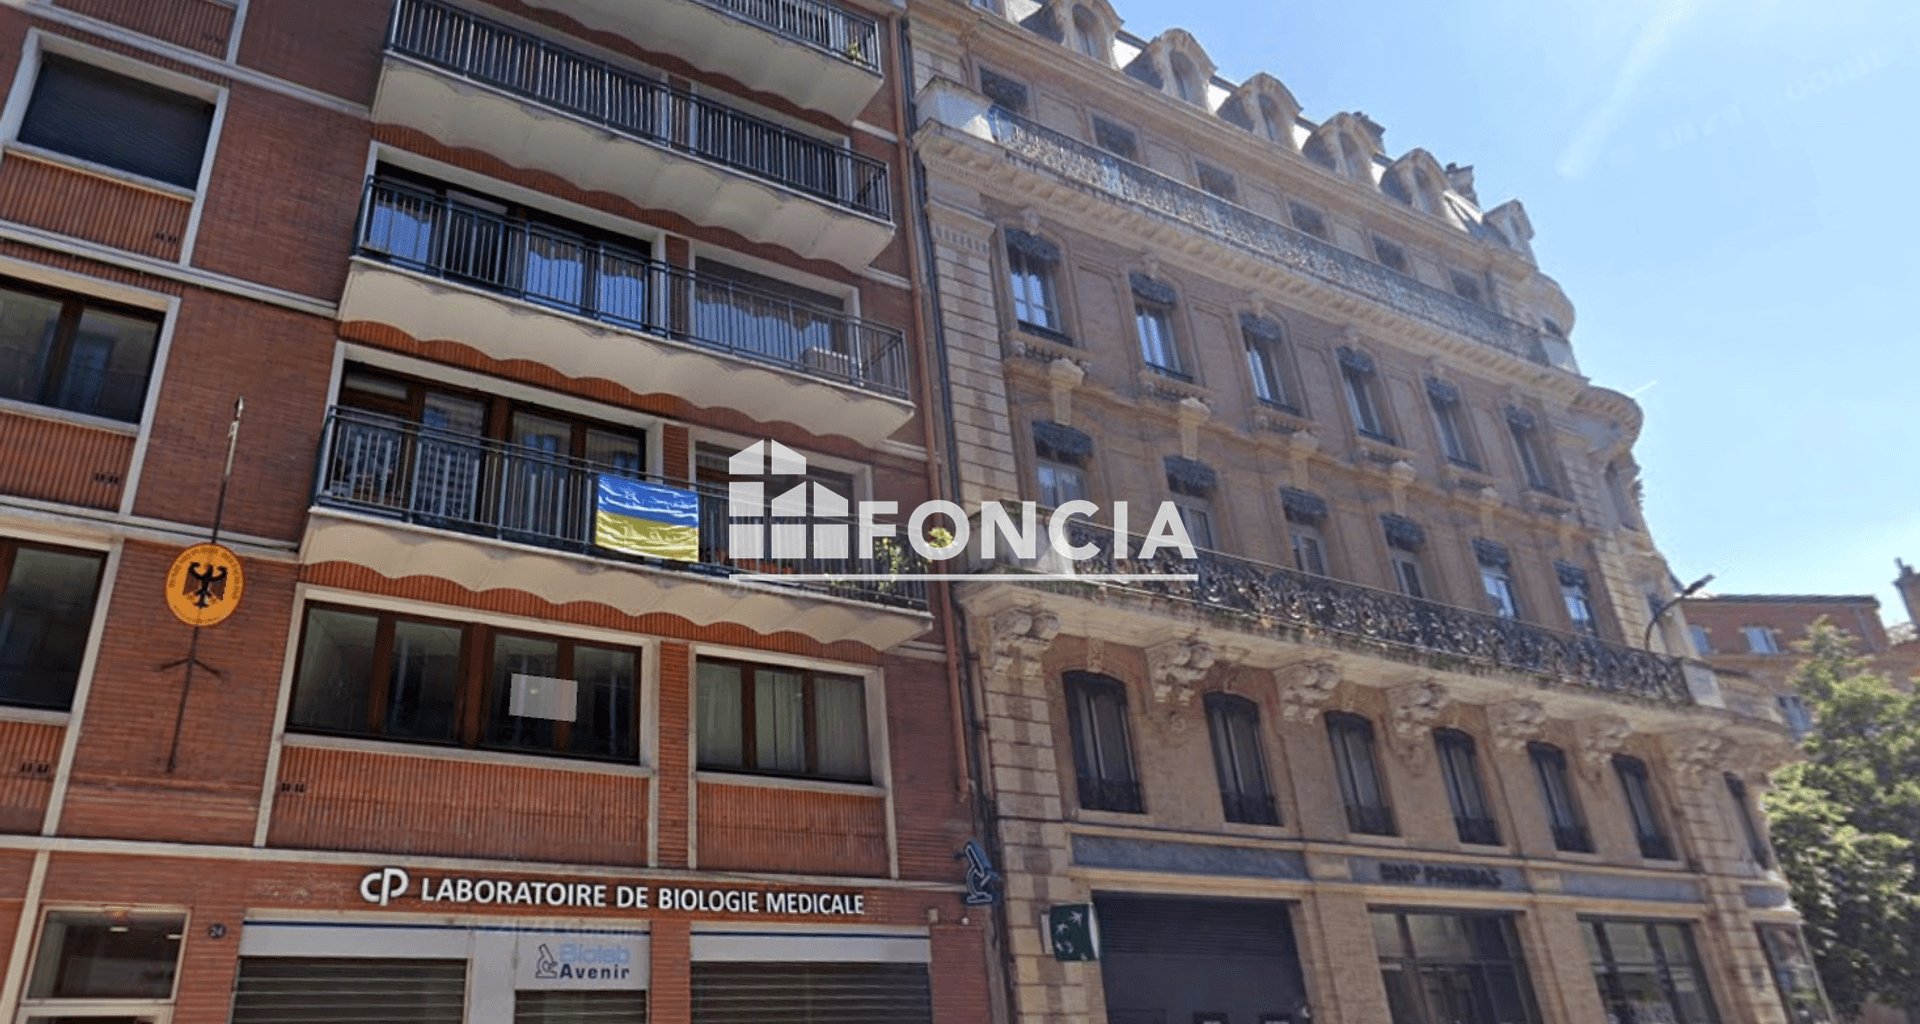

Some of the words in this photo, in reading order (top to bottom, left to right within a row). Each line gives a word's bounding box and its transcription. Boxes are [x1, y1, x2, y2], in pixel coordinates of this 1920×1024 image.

[421, 877, 607, 908] LABORATOIRE
[616, 885, 649, 909] DE
[659, 888, 759, 913] BIOLOGIE
[766, 892, 865, 916] MEDICALE
[559, 963, 630, 980] Avenir
